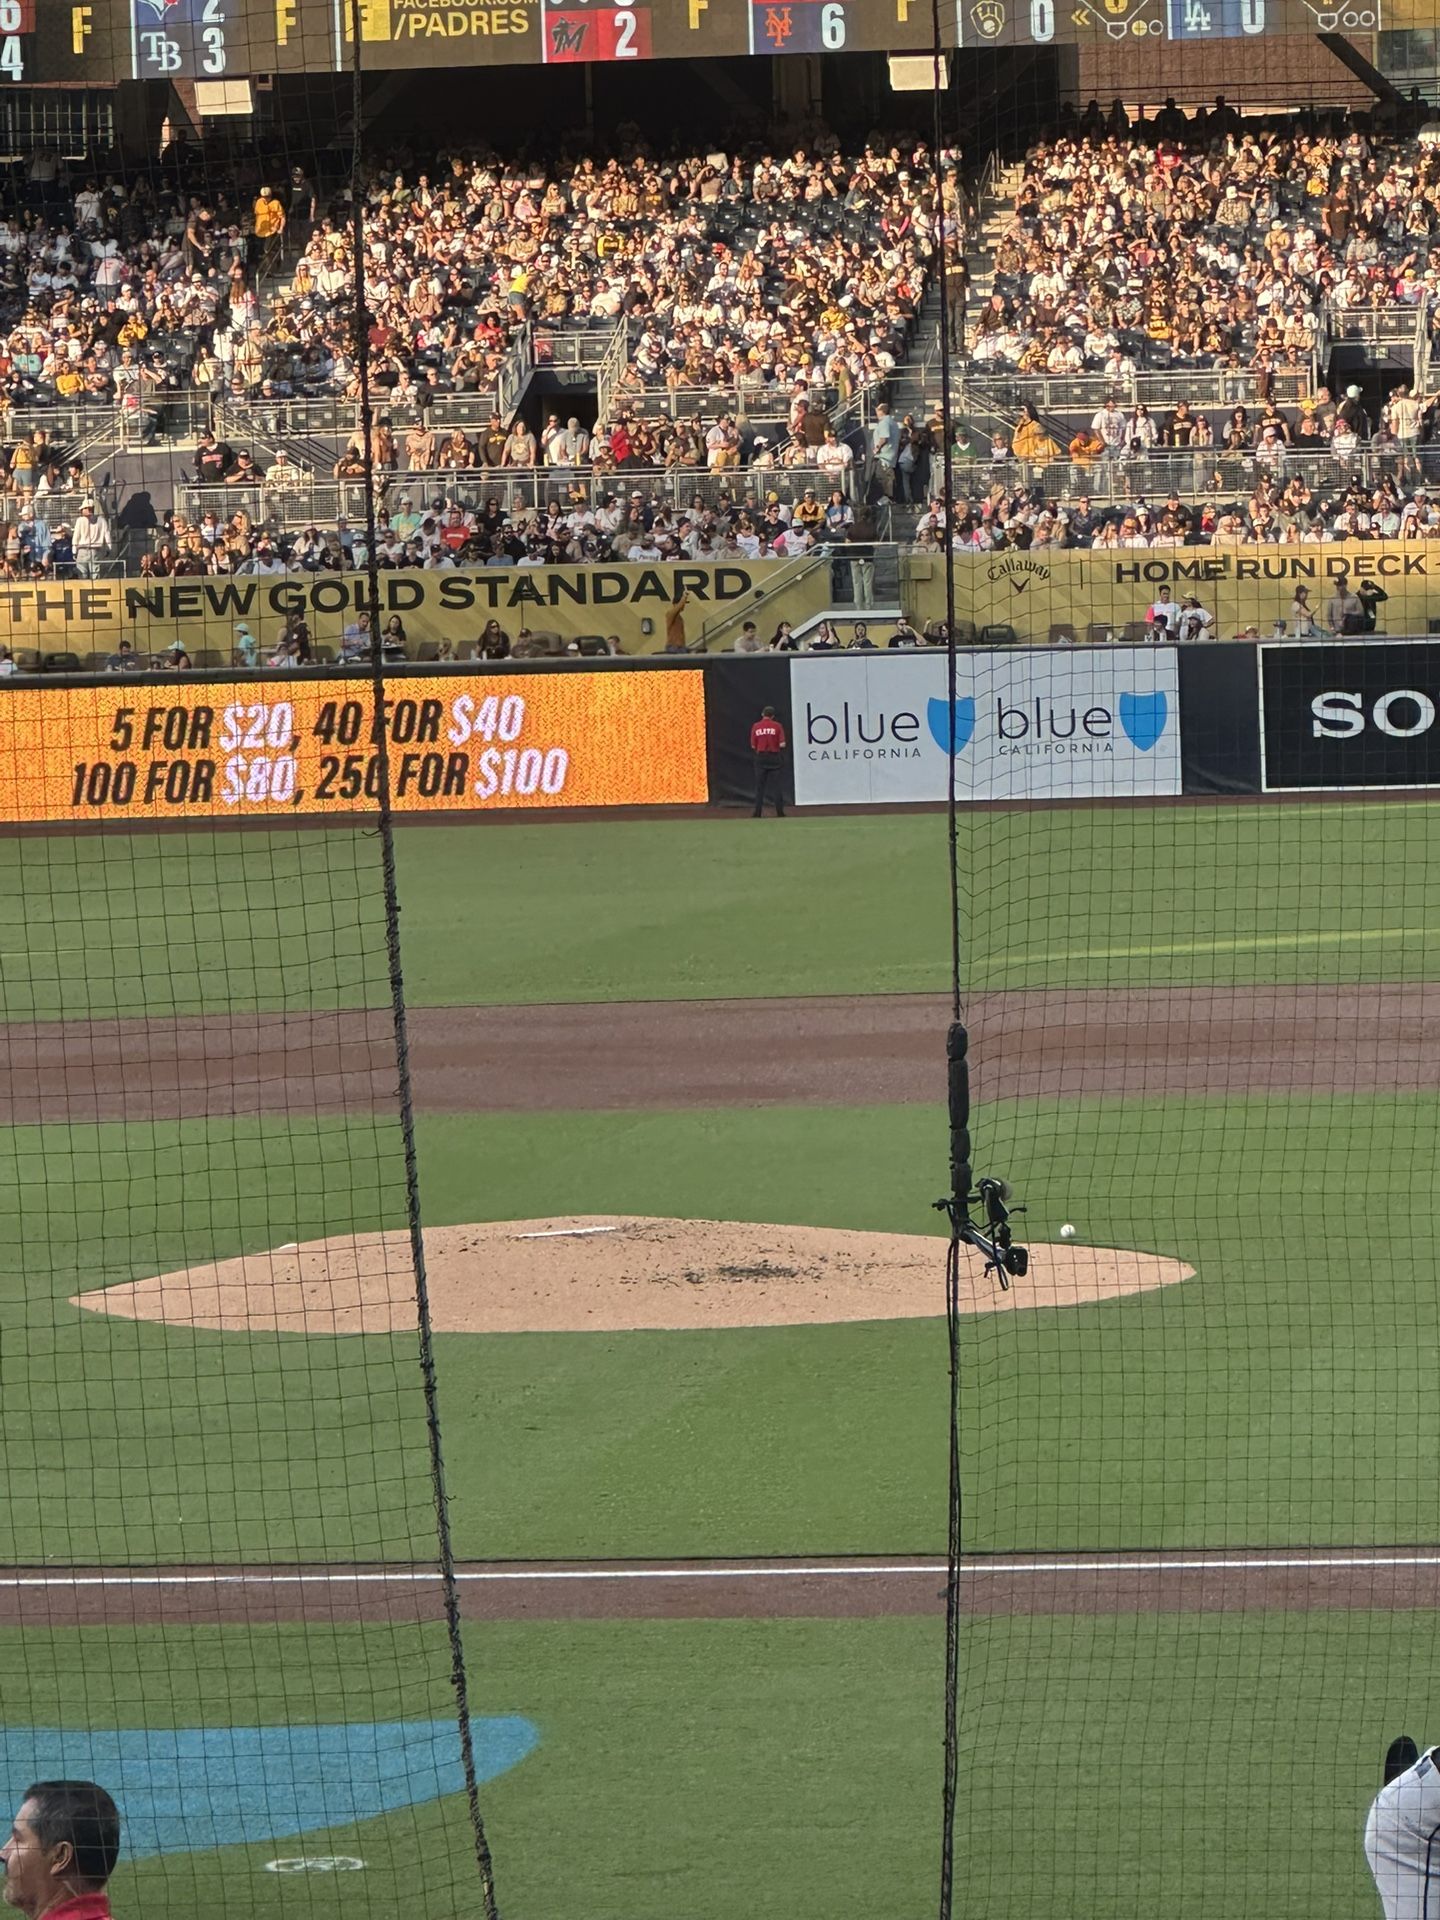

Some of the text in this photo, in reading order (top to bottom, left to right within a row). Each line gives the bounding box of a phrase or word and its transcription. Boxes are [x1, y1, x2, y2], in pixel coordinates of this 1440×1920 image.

[72, 6, 93, 54] F
[614, 10, 638, 57] 2
[821, 2, 847, 49] 6
[0, 35, 24, 81] 4
[140, 31, 183, 71] TB
[202, 27, 227, 74] 3
[987, 558, 1051, 581] Callaway
[1116, 554, 1428, 584] HOME RUN DECK
[0, 588, 113, 622] THE
[125, 583, 258, 619] NEW
[269, 577, 425, 615] GOLD
[109, 706, 136, 752] 5
[142, 705, 215, 751] FOR
[312, 700, 364, 746] 40
[447, 693, 527, 747] $40
[806, 701, 920, 745] blue
[997, 697, 1113, 740] blue
[1311, 689, 1440, 739] SO
[808, 746, 922, 762] CALIFORNIA
[998, 741, 1114, 756] CALIFORNIA
[72, 761, 138, 806] 100
[145, 759, 217, 805] FOR
[396, 752, 469, 797] FOR
[474, 747, 569, 800] $100
